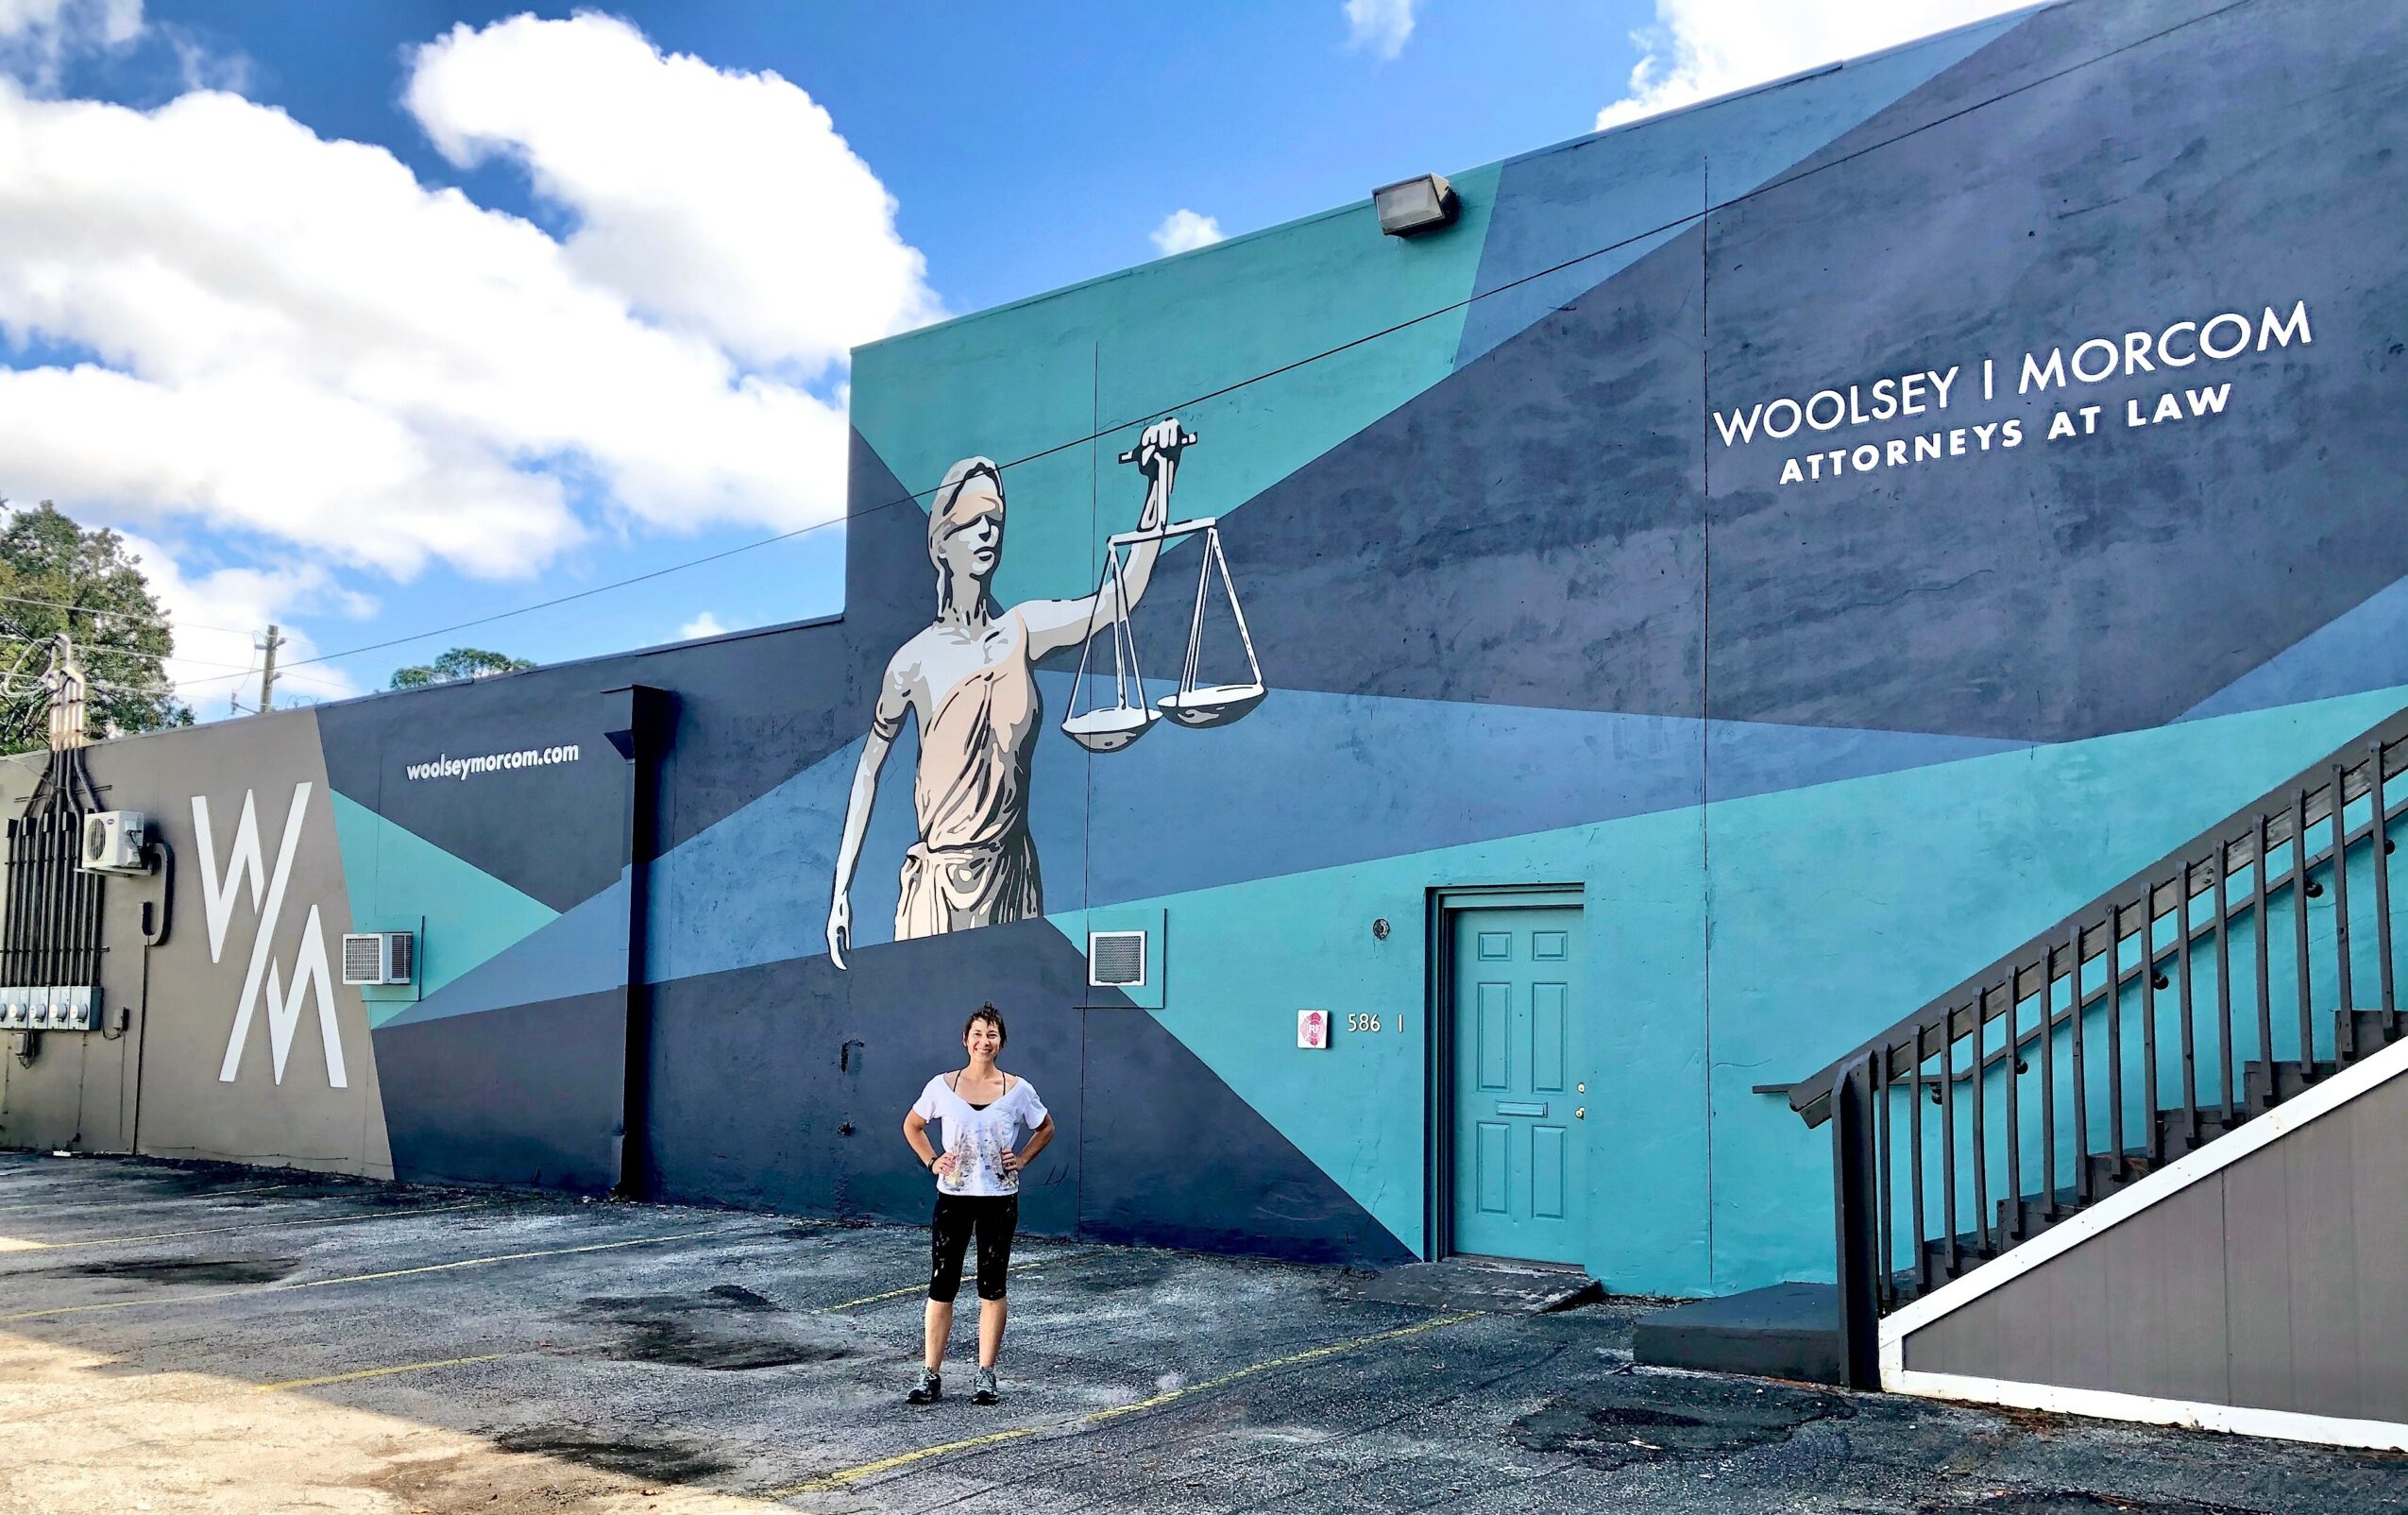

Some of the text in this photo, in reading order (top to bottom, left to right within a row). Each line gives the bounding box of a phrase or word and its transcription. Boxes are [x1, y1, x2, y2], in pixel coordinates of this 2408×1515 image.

[1712, 366, 1959, 447] WOOLSEY
[2018, 299, 2312, 395] MORCOM
[1779, 383, 2231, 485] ATTORNEYS AT LAW
[406, 744, 579, 781] woolseymorcom.com
